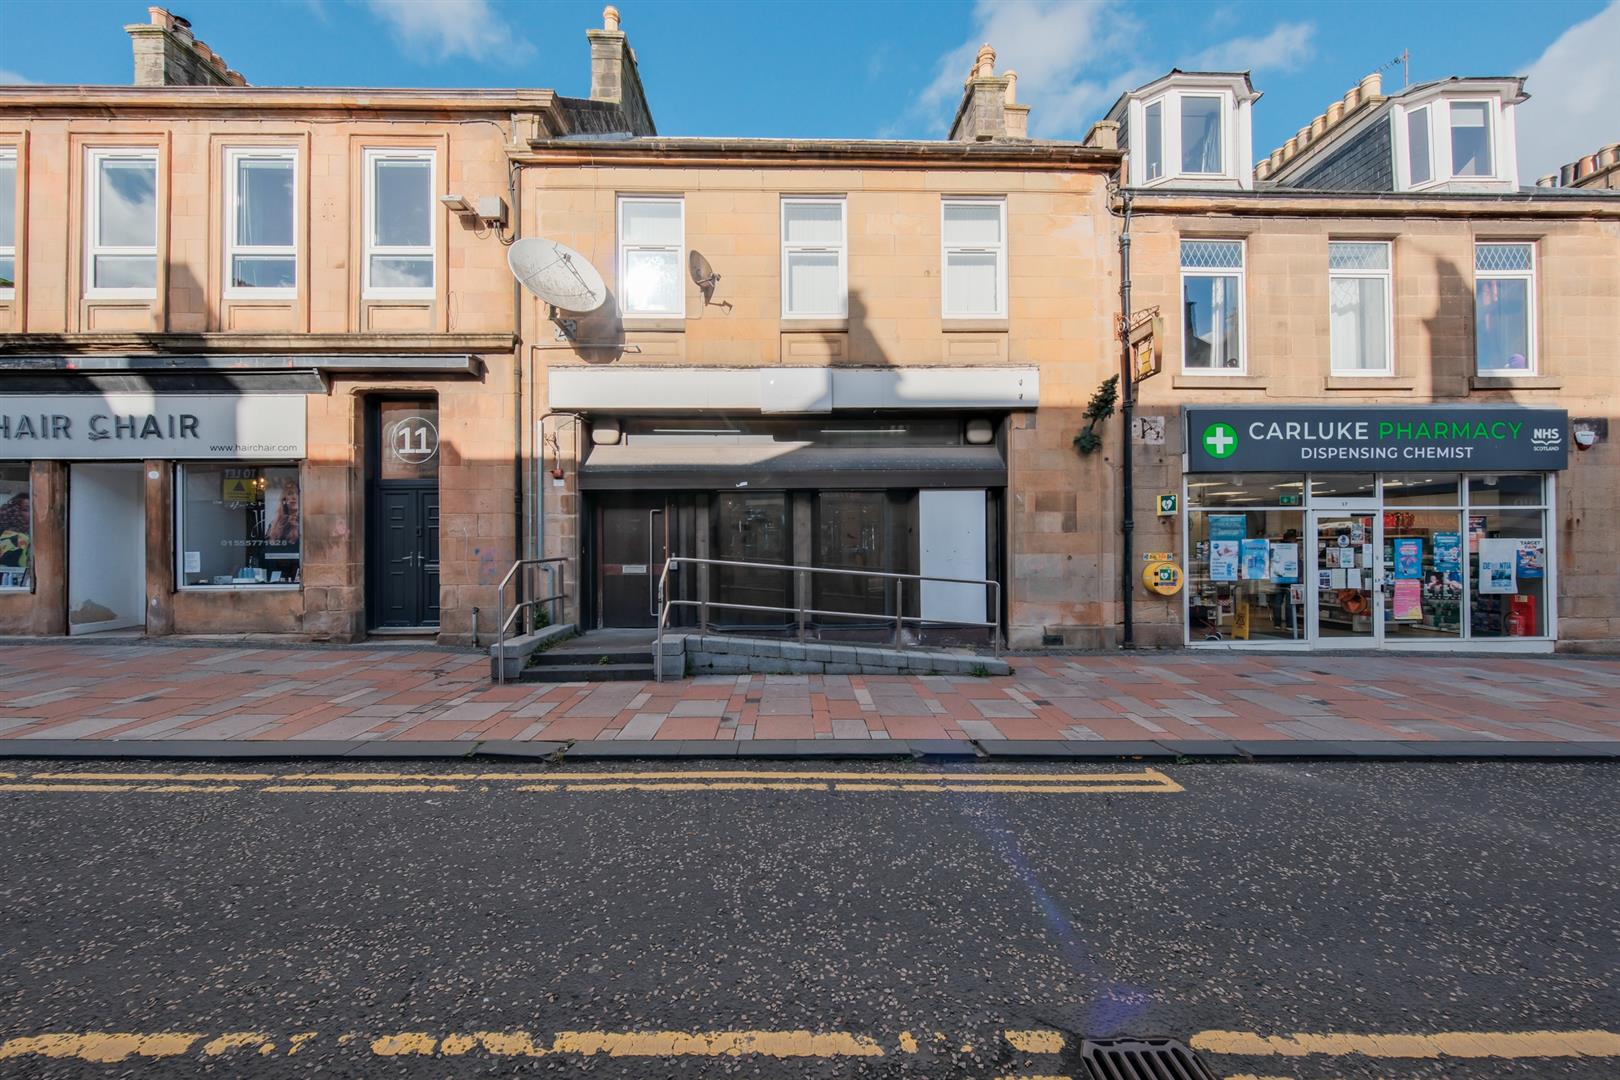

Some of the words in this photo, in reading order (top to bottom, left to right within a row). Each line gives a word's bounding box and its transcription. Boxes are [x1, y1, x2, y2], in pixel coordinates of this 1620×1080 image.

[88, 414, 200, 441] CHAIR
[1249, 421, 1369, 441] CARLUKE
[1377, 421, 1523, 440] PHARMACY
[1533, 428, 1560, 439] NHS
[209, 443, 298, 452] www.hairchair.com
[399, 427, 431, 454] 11
[1301, 447, 1398, 459] DISPENSING
[1403, 447, 1474, 459] CHEMIST
